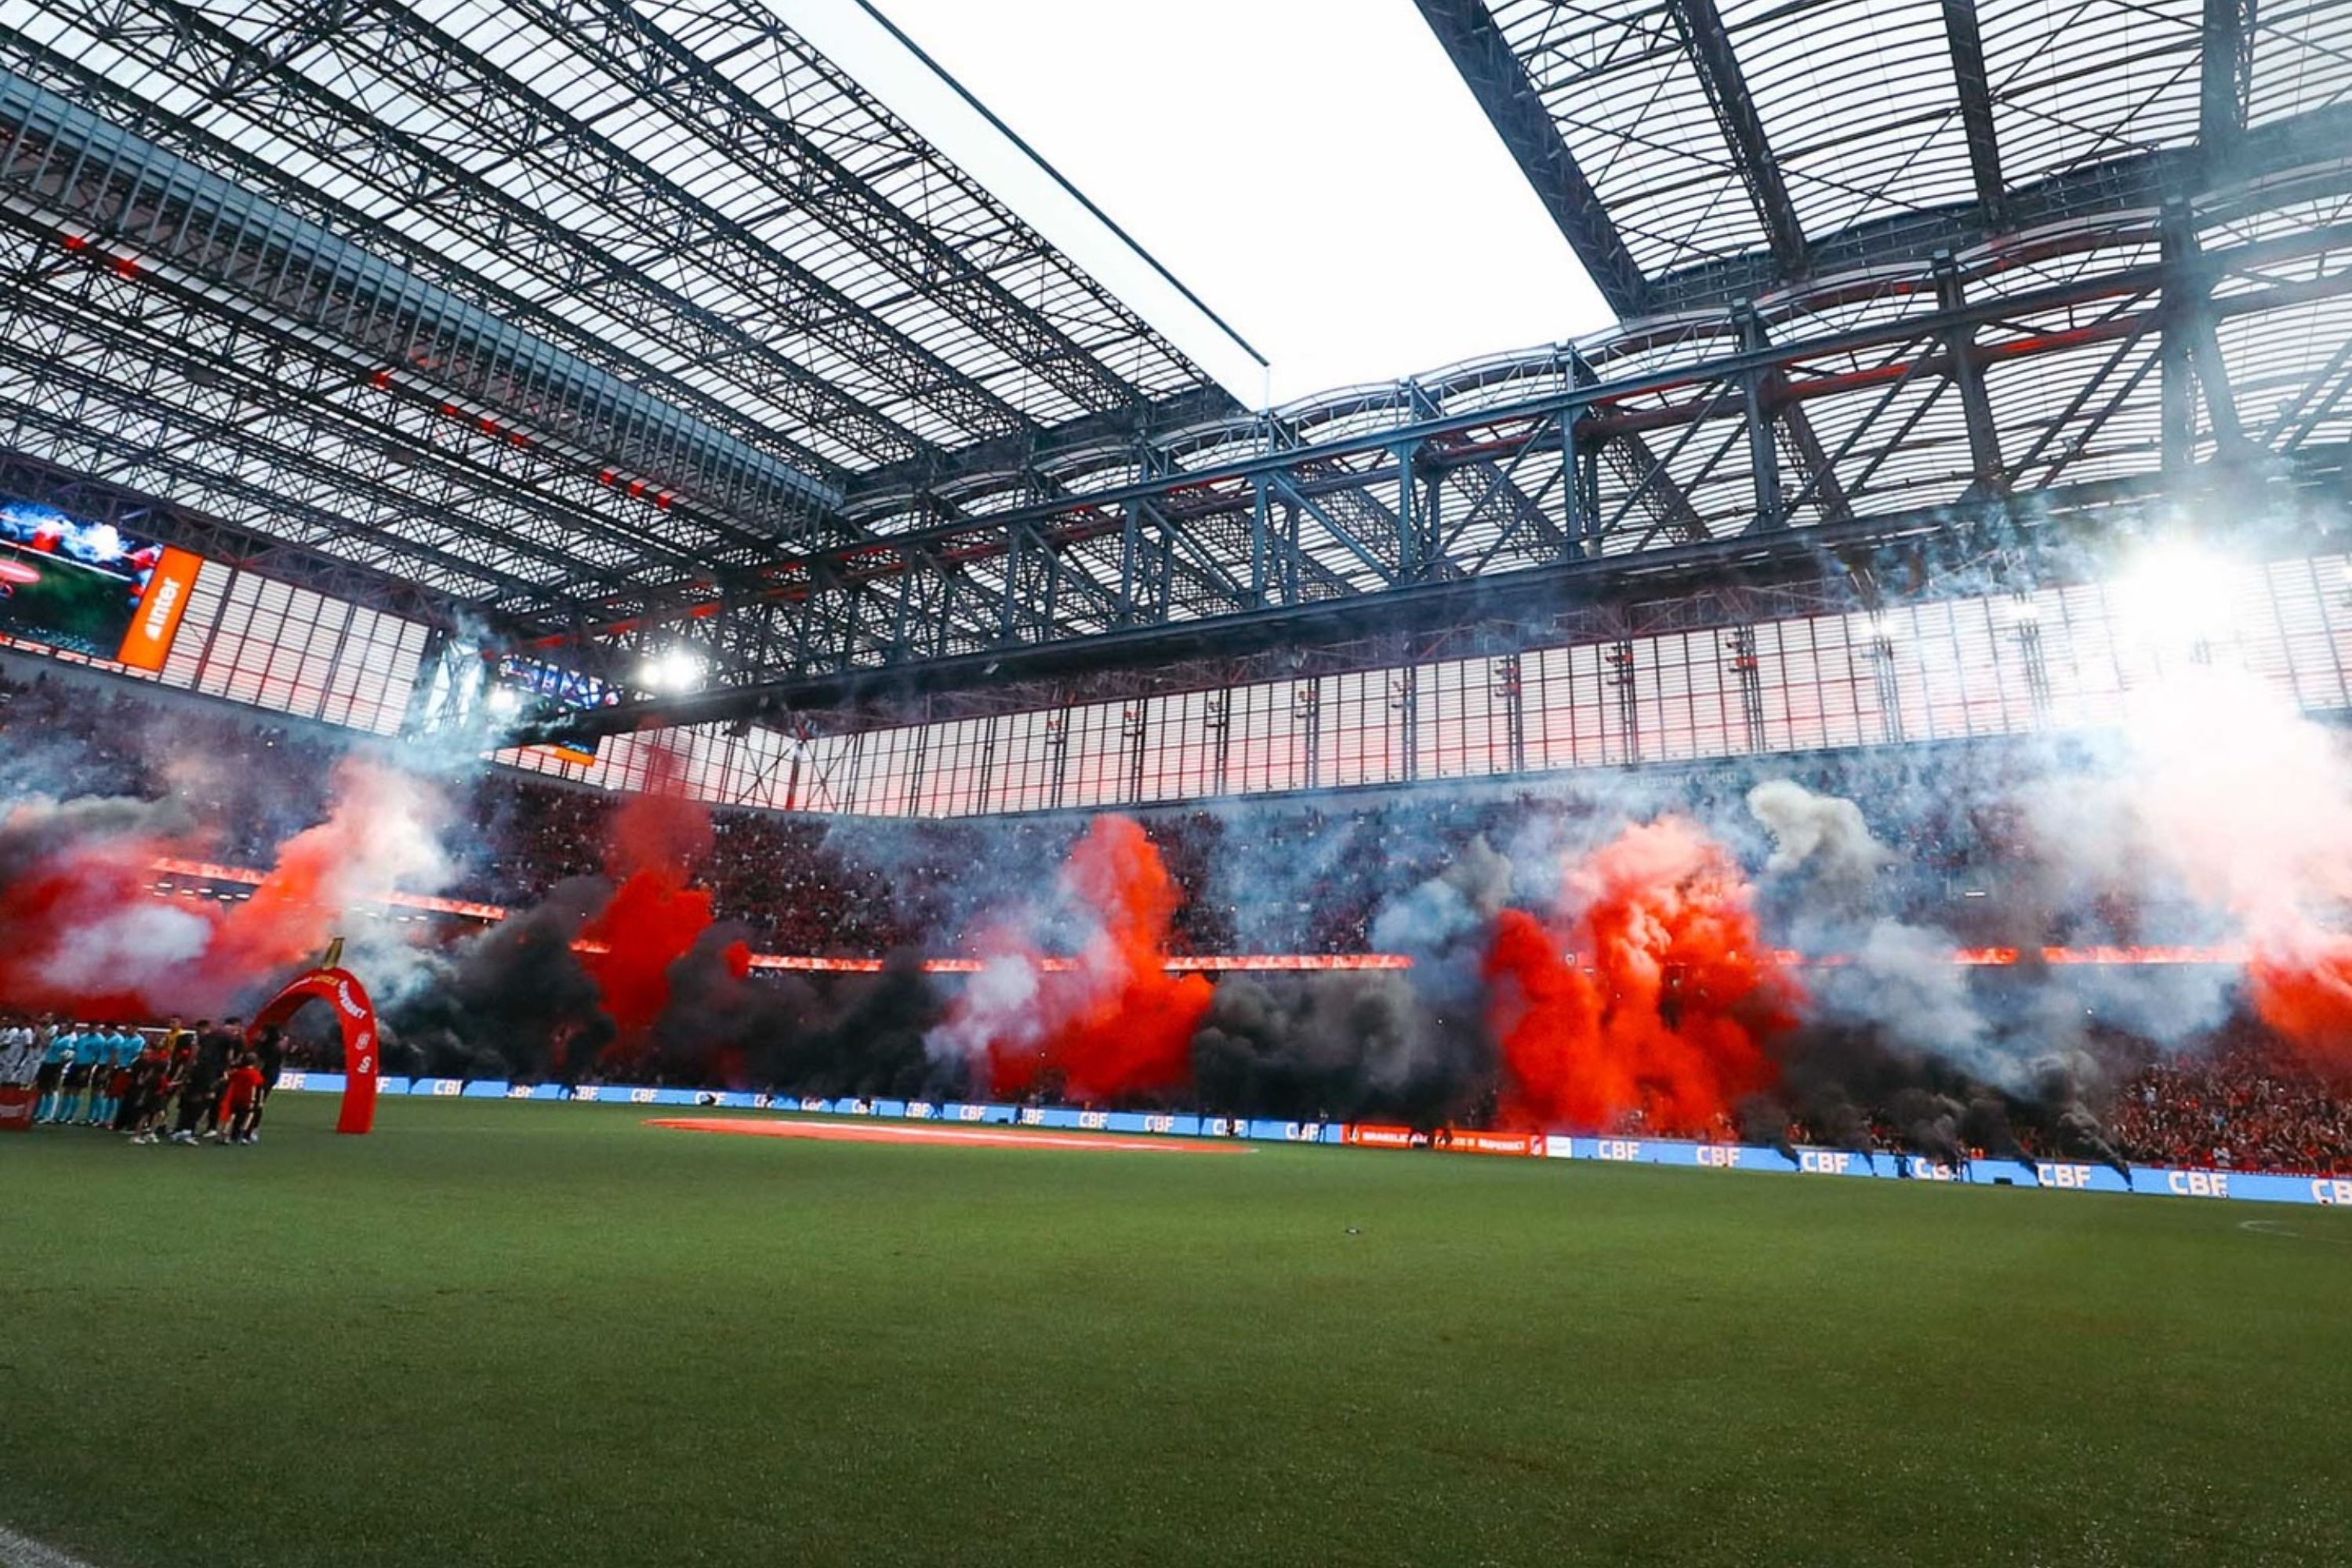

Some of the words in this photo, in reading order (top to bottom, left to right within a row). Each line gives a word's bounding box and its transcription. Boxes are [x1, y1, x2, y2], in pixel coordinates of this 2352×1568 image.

[273, 1073, 308, 1090] BF
[631, 1087, 659, 1103] CBF
[695, 1091, 727, 1106] CF
[959, 1105, 986, 1121] CBF
[1079, 1111, 1109, 1129] CBF
[1145, 1115, 1174, 1132] CBF
[1598, 1139, 1640, 1160] CBF
[1696, 1145, 1741, 1167] CBF
[1802, 1151, 1850, 1174] CBF
[2038, 1163, 2092, 1188] CBF
[2168, 1171, 2227, 1197] CBF
